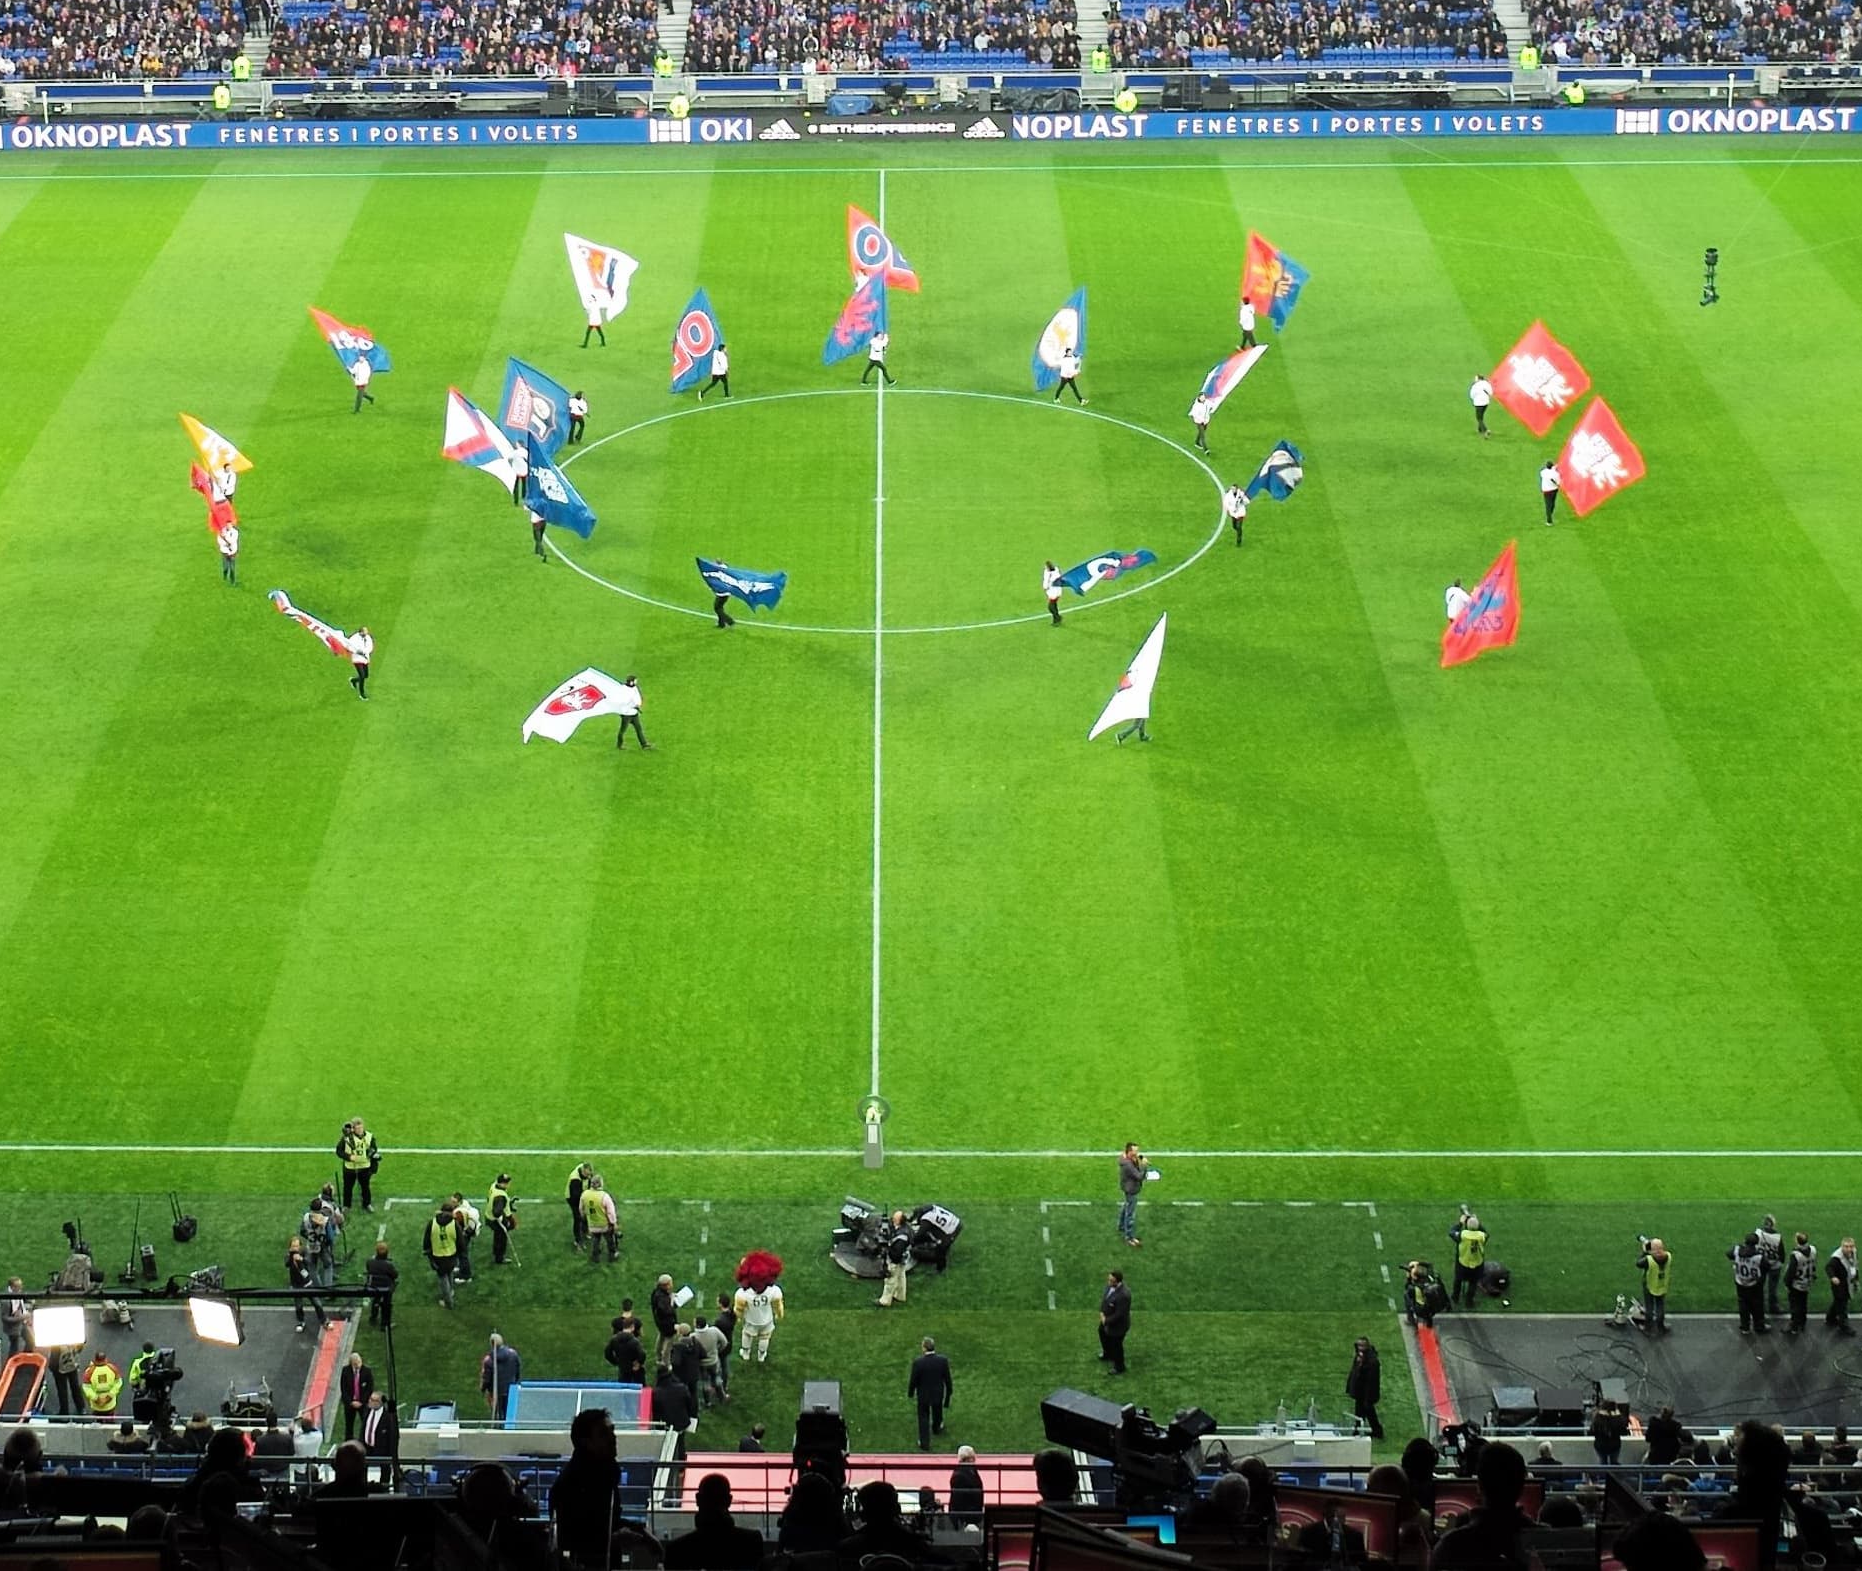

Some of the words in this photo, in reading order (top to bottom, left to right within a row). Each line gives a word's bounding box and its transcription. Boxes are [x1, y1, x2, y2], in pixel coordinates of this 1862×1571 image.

[1177, 116, 1300, 134] FENÊTRES
[1331, 117, 1422, 132] PORTES
[1453, 116, 1544, 132] VOLETS
[1667, 108, 1856, 133] OKNOPLAST
[12, 124, 193, 149] OKNOPLAST
[220, 126, 340, 143] FENÊTRES
[370, 127, 459, 142] PORTES
[489, 125, 578, 140] VOLETS
